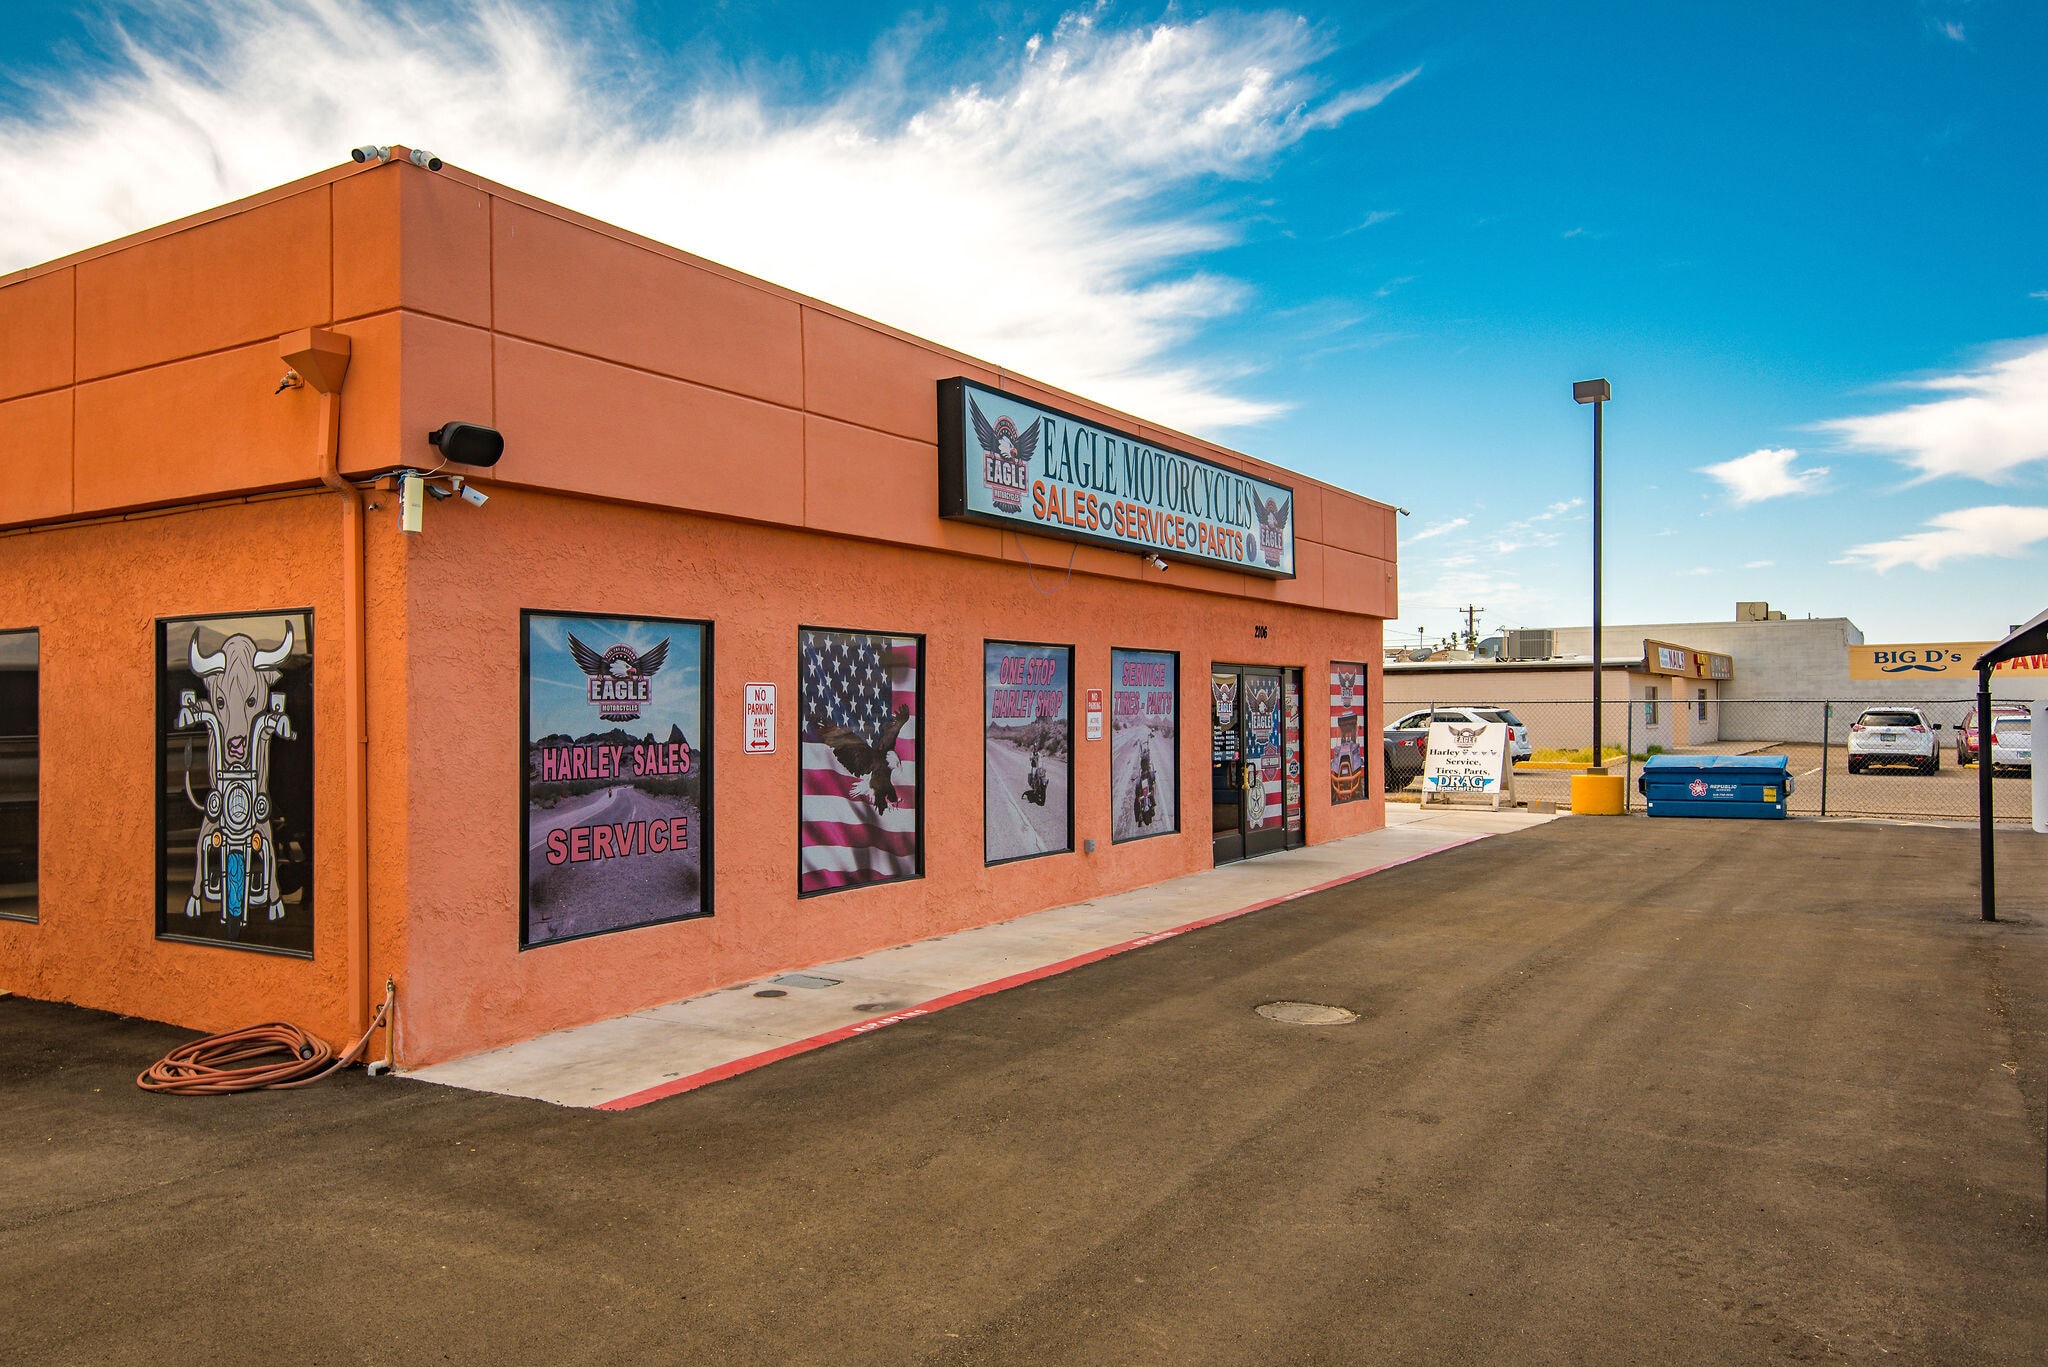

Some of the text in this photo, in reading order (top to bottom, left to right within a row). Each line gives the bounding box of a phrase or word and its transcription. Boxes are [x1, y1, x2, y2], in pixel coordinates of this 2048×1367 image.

[986, 457, 1026, 490] EAGLE
[1042, 416, 1252, 530] EAGLE MOTORCYCLES
[1032, 480, 1244, 562] SALES SERVICE PARTS
[1261, 528, 1283, 550] EAGLE
[1668, 649, 1685, 669] NAILS
[1874, 650, 1962, 664] BIG D's
[1000, 656, 1057, 686] ONE STOP
[1121, 661, 1166, 687] SERVICE
[592, 680, 647, 700] EAGLE
[754, 689, 766, 701] NO
[747, 703, 774, 715] PARKING
[992, 689, 1063, 719] HARLEY SHOP
[1114, 691, 1140, 716] TIRES
[1146, 691, 1172, 715] PARTS
[754, 718, 767, 727] ANY
[1253, 715, 1271, 728] EAGLE
[753, 728, 768, 738] TIME
[542, 743, 691, 782] HARLEY SALES
[1429, 748, 1460, 758] Harley
[1446, 758, 1482, 766] Service,
[1435, 767, 1491, 776] Tires, Parts,
[1437, 775, 1484, 789] DRAG
[546, 817, 689, 866] SERVICE
